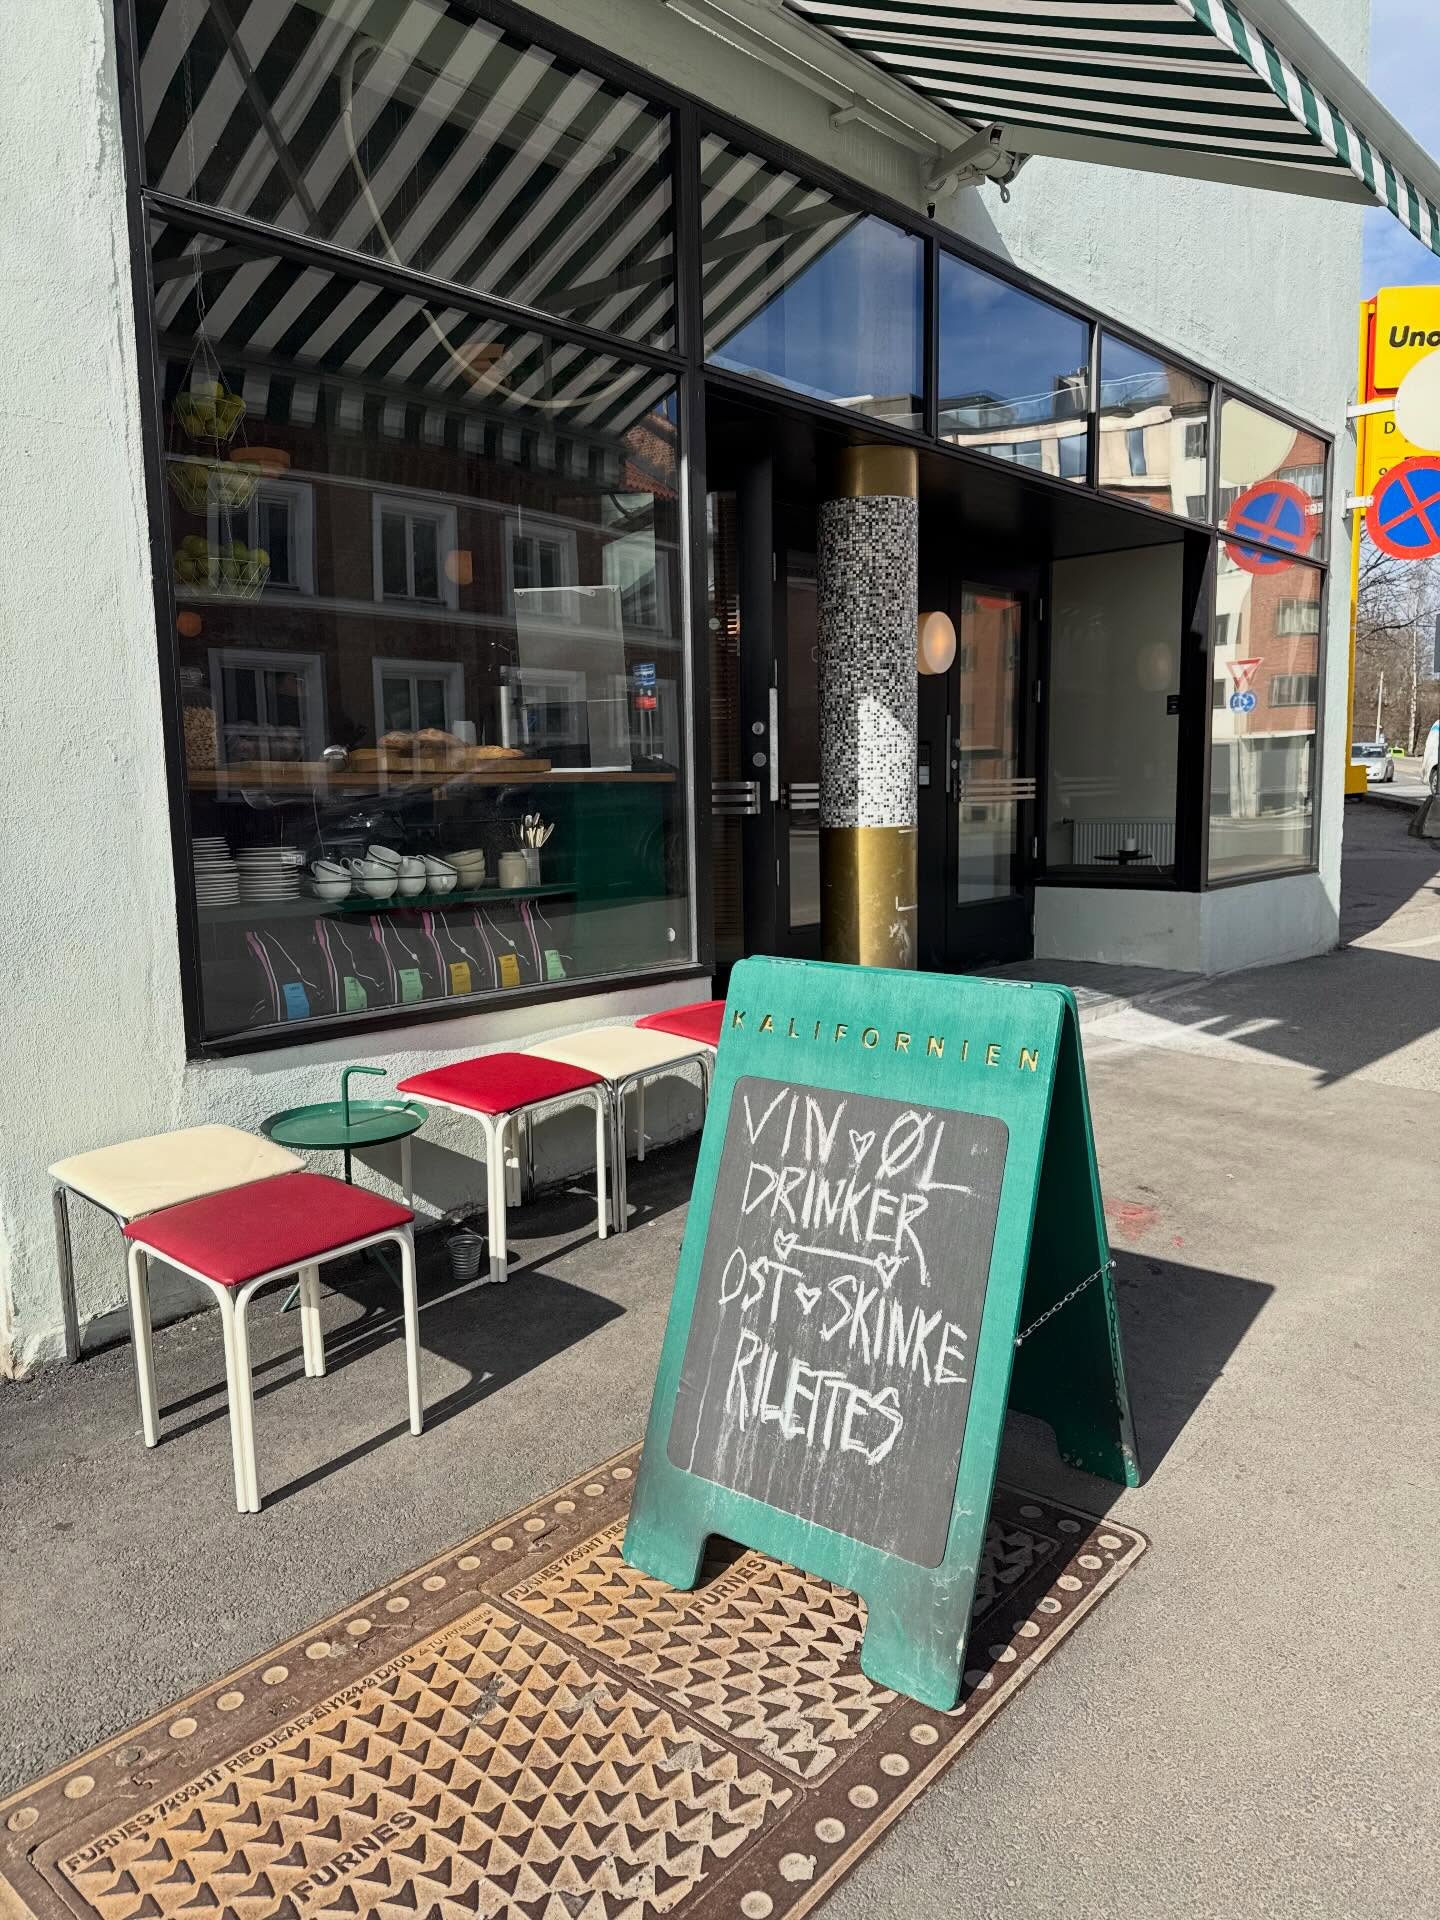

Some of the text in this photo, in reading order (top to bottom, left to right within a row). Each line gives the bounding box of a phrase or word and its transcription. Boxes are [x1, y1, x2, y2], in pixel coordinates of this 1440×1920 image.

[731, 1009, 1041, 1073] KALIFORNIEN
[743, 1087, 974, 1194] VIN ØL
[740, 1161, 931, 1287] DRINKER
[718, 1246, 969, 1387] OST SKINKE
[725, 1327, 905, 1466] RILETTES
[508, 1562, 564, 1599] FURNES
[689, 1559, 767, 1616] FURNES
[65, 1814, 157, 1872] FURNES
[153, 1770, 222, 1819] 7293HT
[227, 1714, 315, 1774] REGULAR
[376, 1654, 416, 1682] D400
[290, 1811, 417, 1904] FURNES
